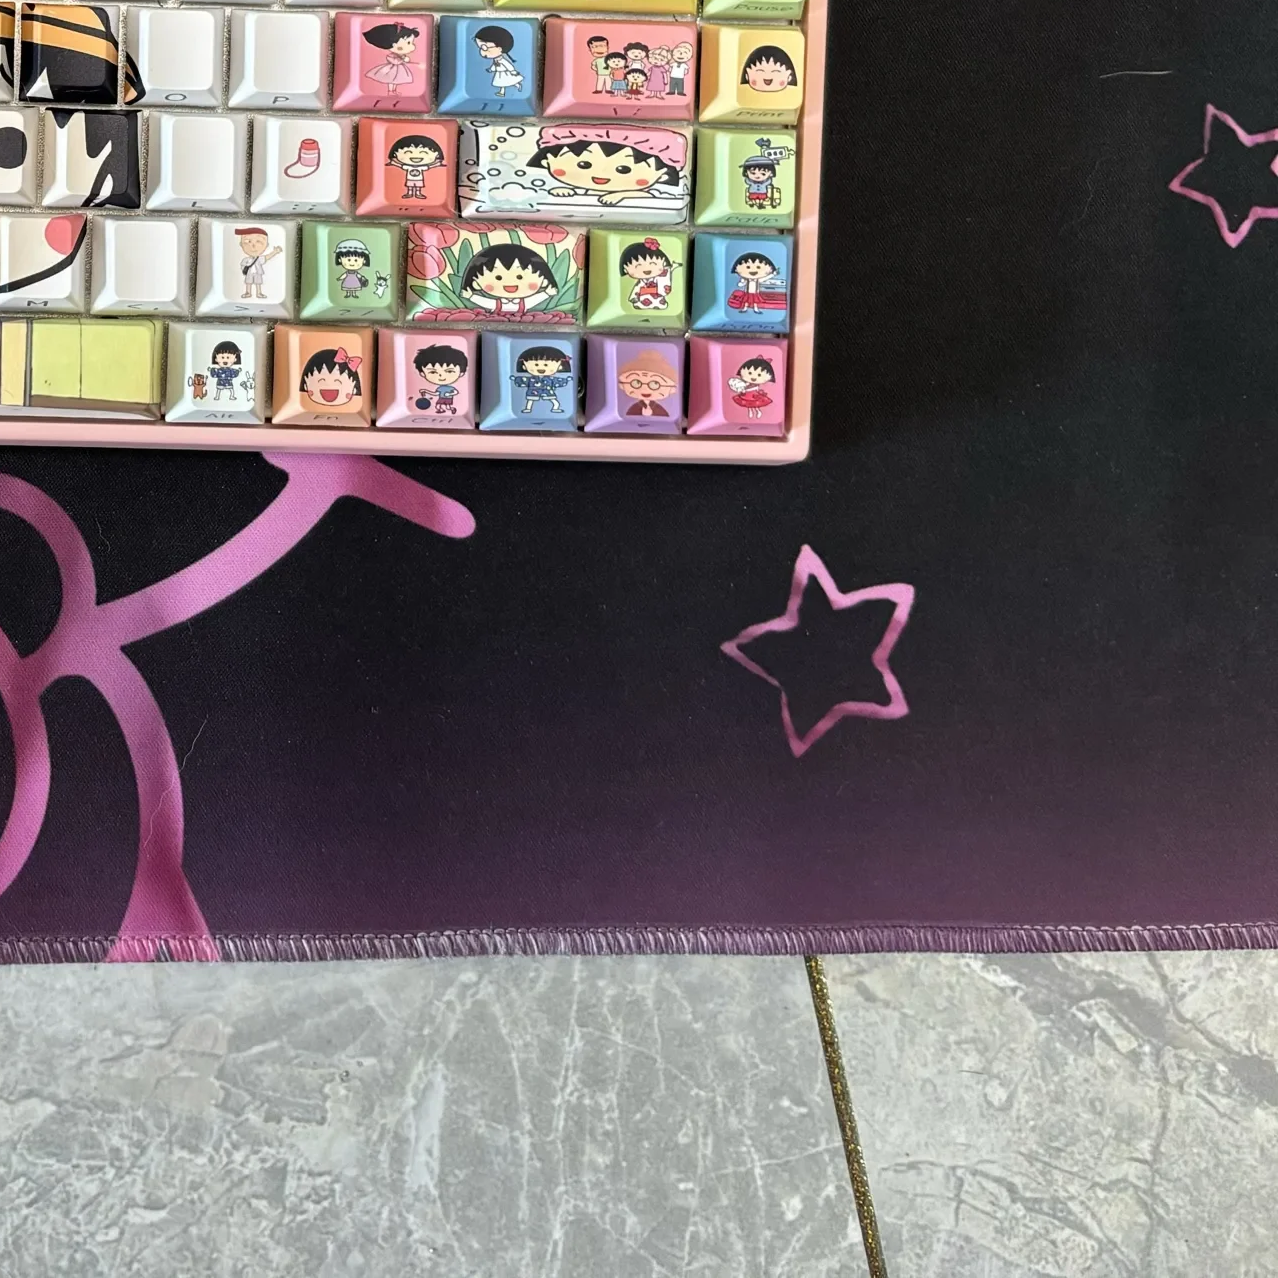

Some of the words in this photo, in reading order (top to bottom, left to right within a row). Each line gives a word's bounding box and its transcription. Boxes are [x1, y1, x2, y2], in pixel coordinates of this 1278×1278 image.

[272, 95, 290, 105] P
[735, 109, 785, 118] Print
[26, 299, 49, 308] M
[204, 412, 235, 420] Alt
